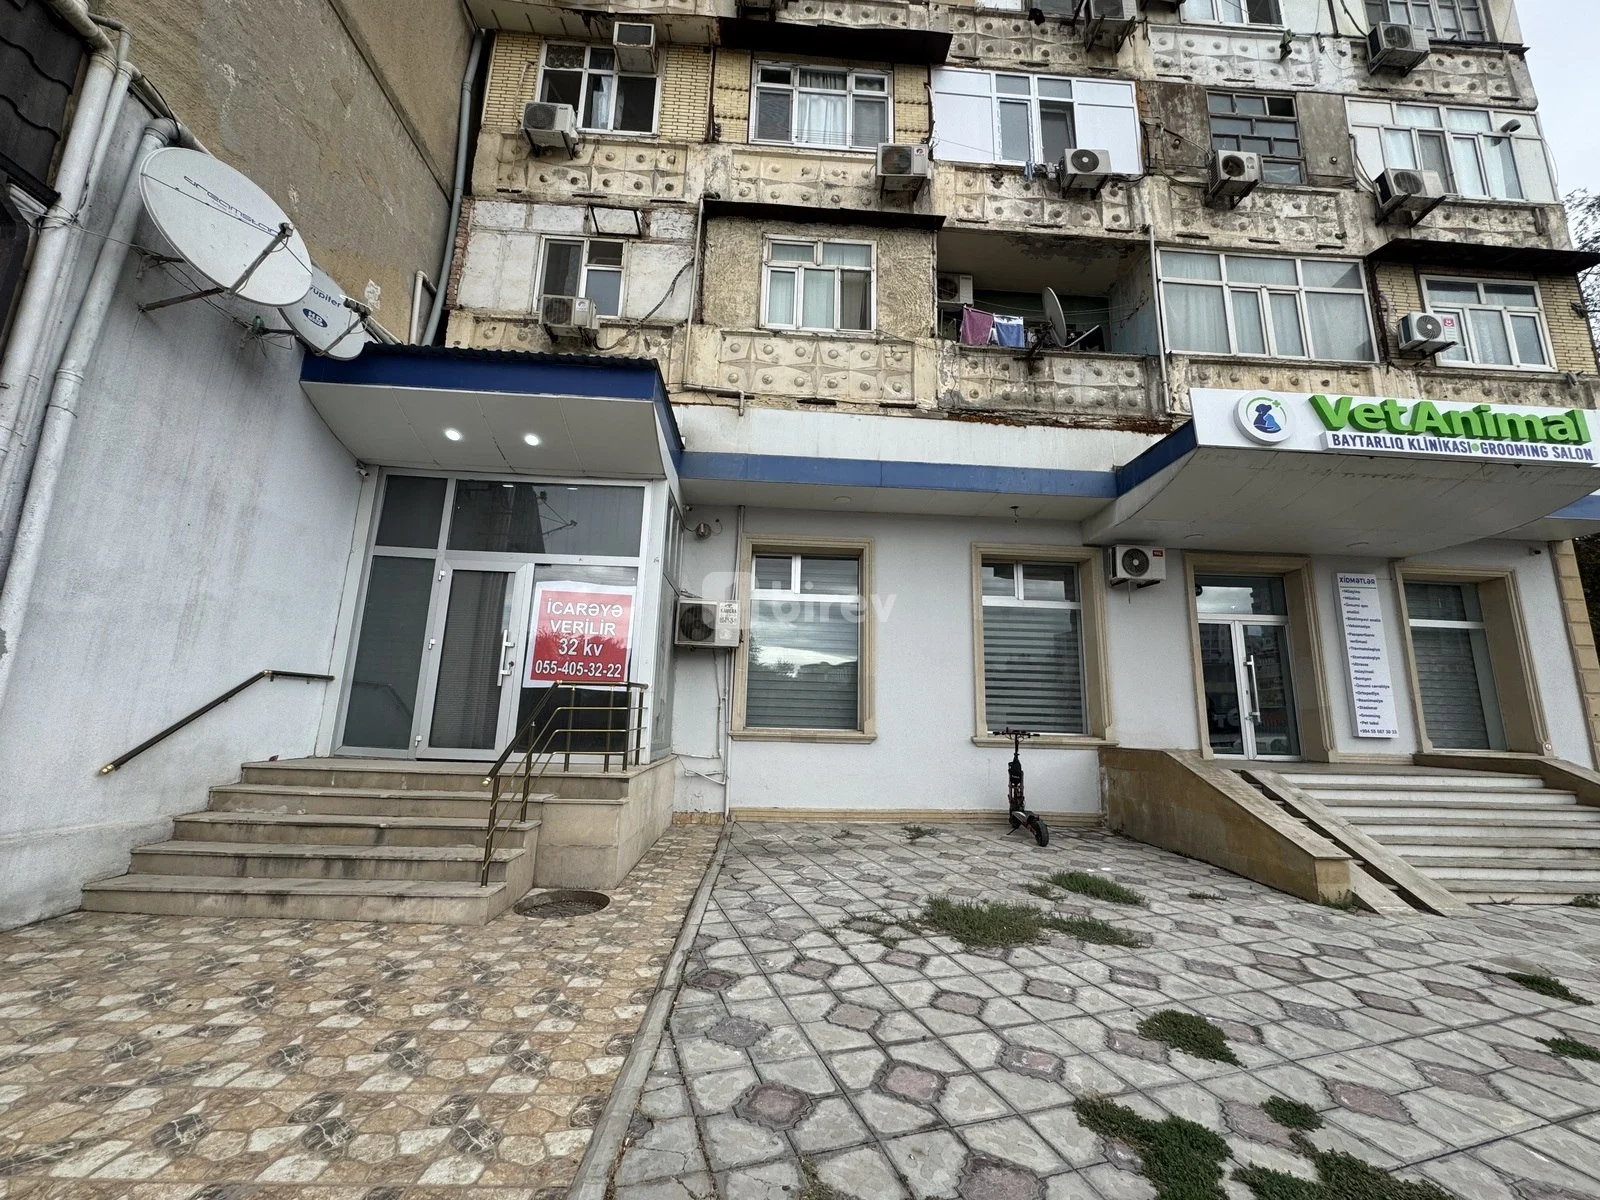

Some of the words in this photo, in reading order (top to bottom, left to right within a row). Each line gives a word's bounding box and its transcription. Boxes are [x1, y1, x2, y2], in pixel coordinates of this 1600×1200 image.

[1309, 395, 1592, 446] VetAnimal
[1332, 432, 1404, 451] BAYTARLIQ
[1408, 435, 1473, 455] KLİNİKASI
[1479, 441, 1549, 459] GROOMING
[1552, 444, 1594, 462] SALON
[547, 598, 623, 617] İCARƏYƏ
[550, 619, 616, 635] VERİLİR
[558, 638, 579, 656] 32
[583, 639, 603, 656] kv
[535, 660, 622, 678] 055-405-32-22
